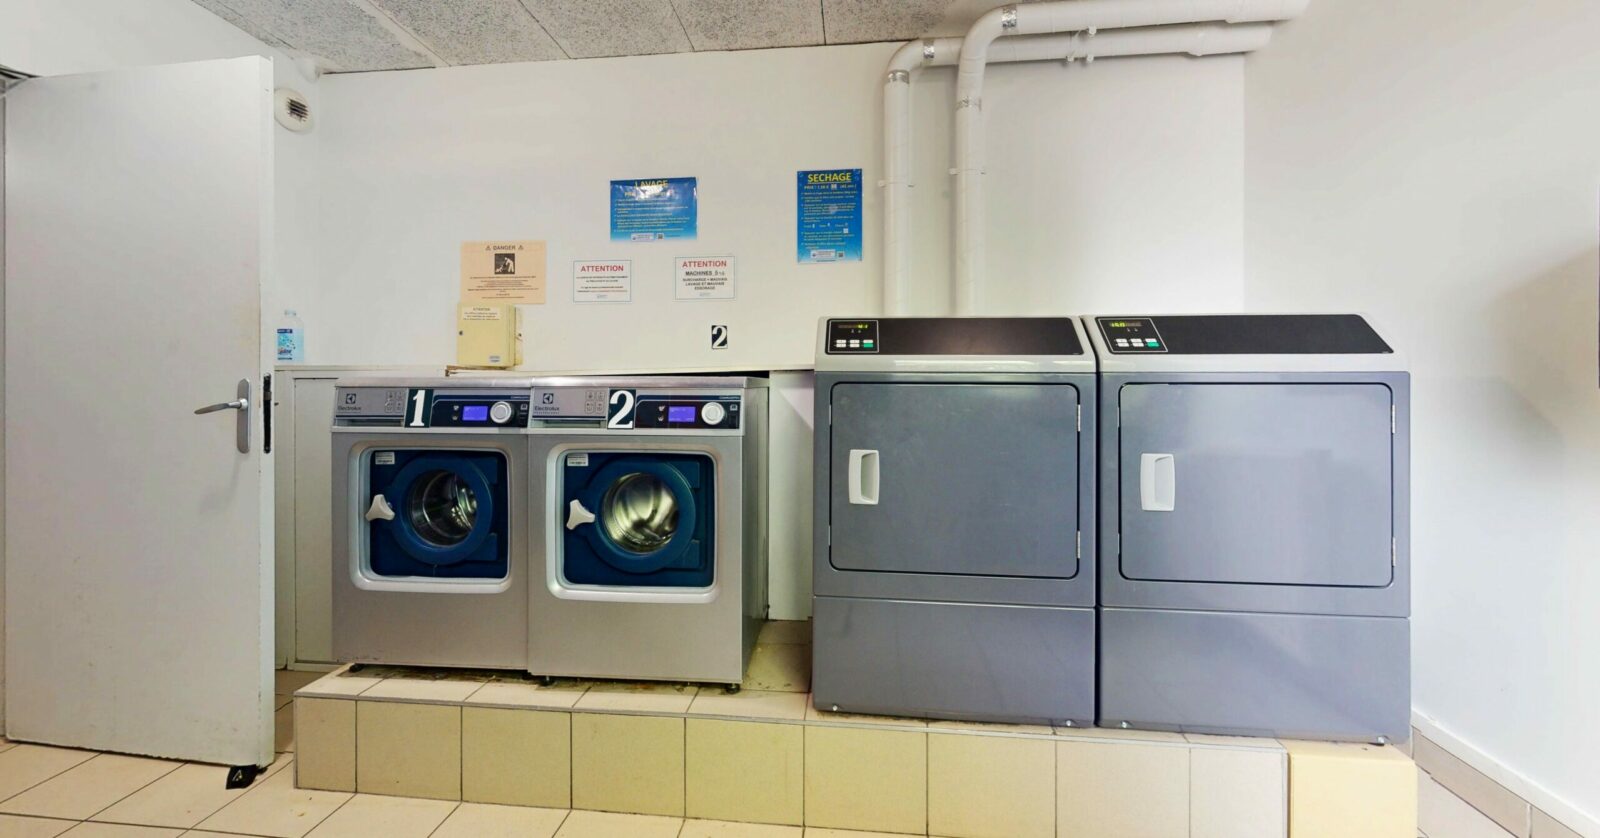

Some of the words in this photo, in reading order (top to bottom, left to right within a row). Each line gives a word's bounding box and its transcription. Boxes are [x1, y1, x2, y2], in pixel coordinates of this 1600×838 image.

[634, 180, 668, 188] LAVAGE
[808, 173, 851, 182] SECHAGE
[682, 260, 727, 268] ATTENTION
[712, 325, 728, 349] 2
[409, 389, 426, 426] 1
[608, 389, 634, 429] 2
